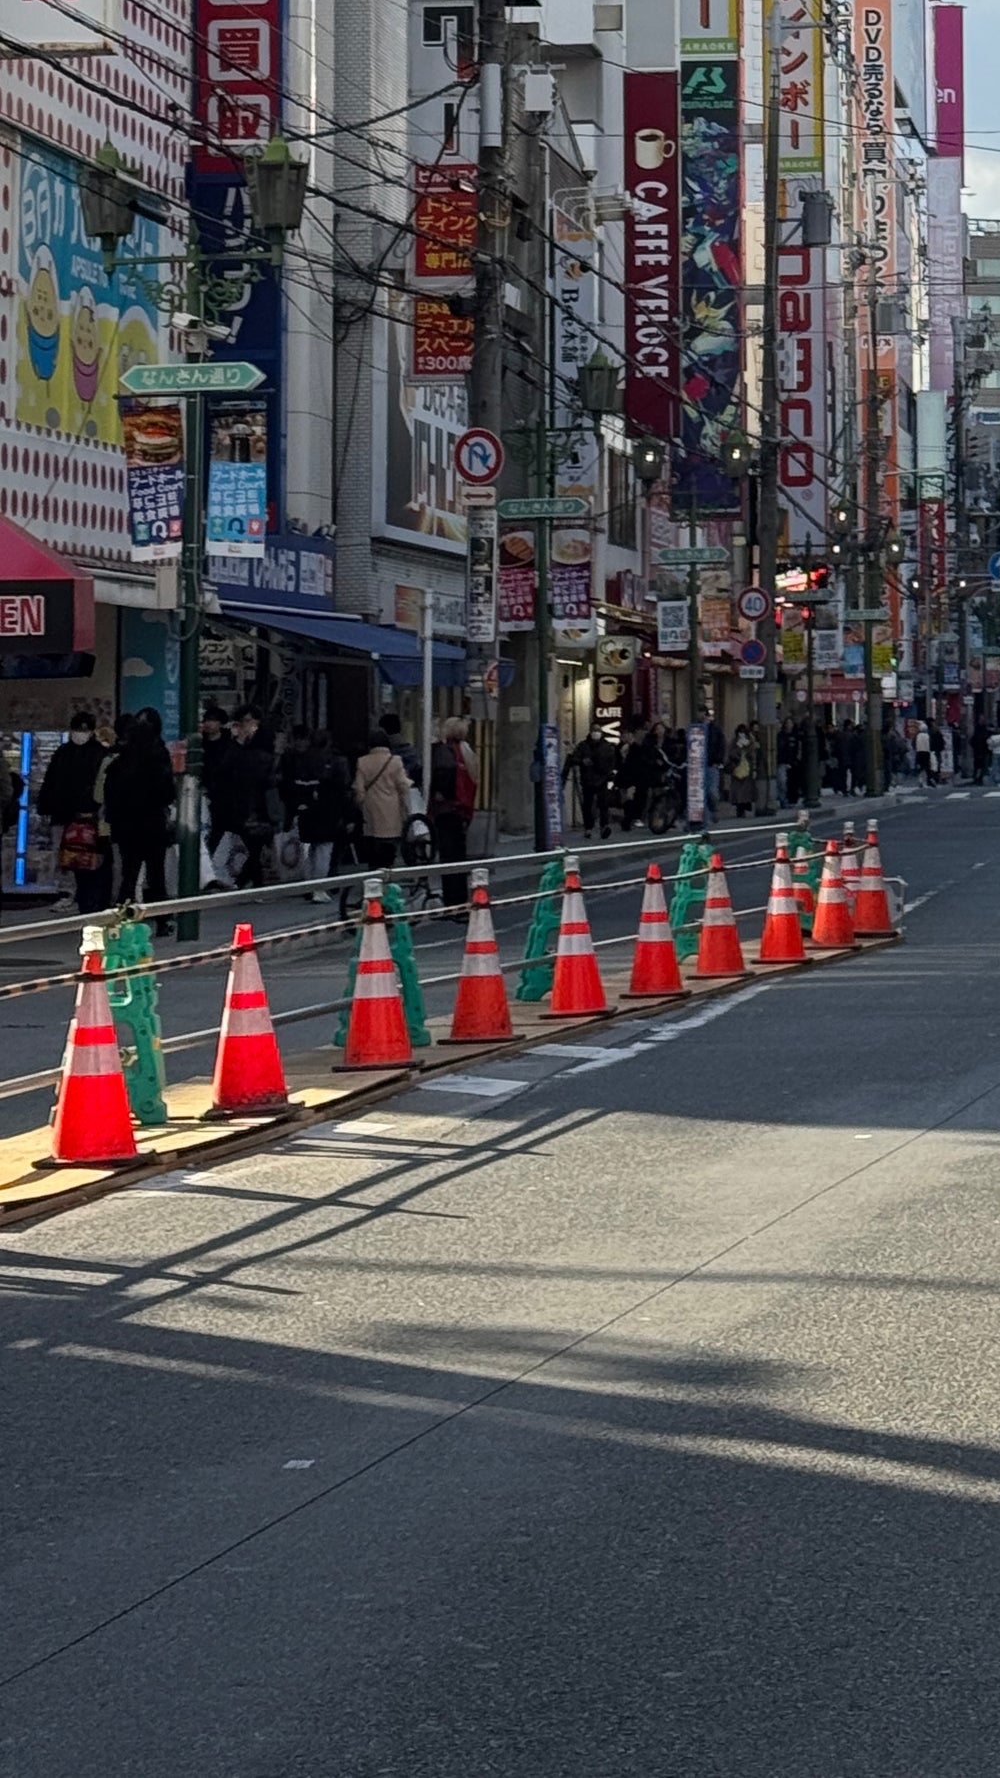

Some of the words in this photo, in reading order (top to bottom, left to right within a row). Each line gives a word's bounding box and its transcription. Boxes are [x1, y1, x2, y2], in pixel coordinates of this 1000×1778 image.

[684, 42, 735, 52] ARAOKE
[863, 10, 885, 136] DVD売るなら
[634, 180, 669, 266] CAFFE
[634, 274, 669, 378] VELOCE
[142, 367, 241, 386] なんさん通り
[743, 596, 763, 612] 40
[596, 707, 623, 719] CAFFE
